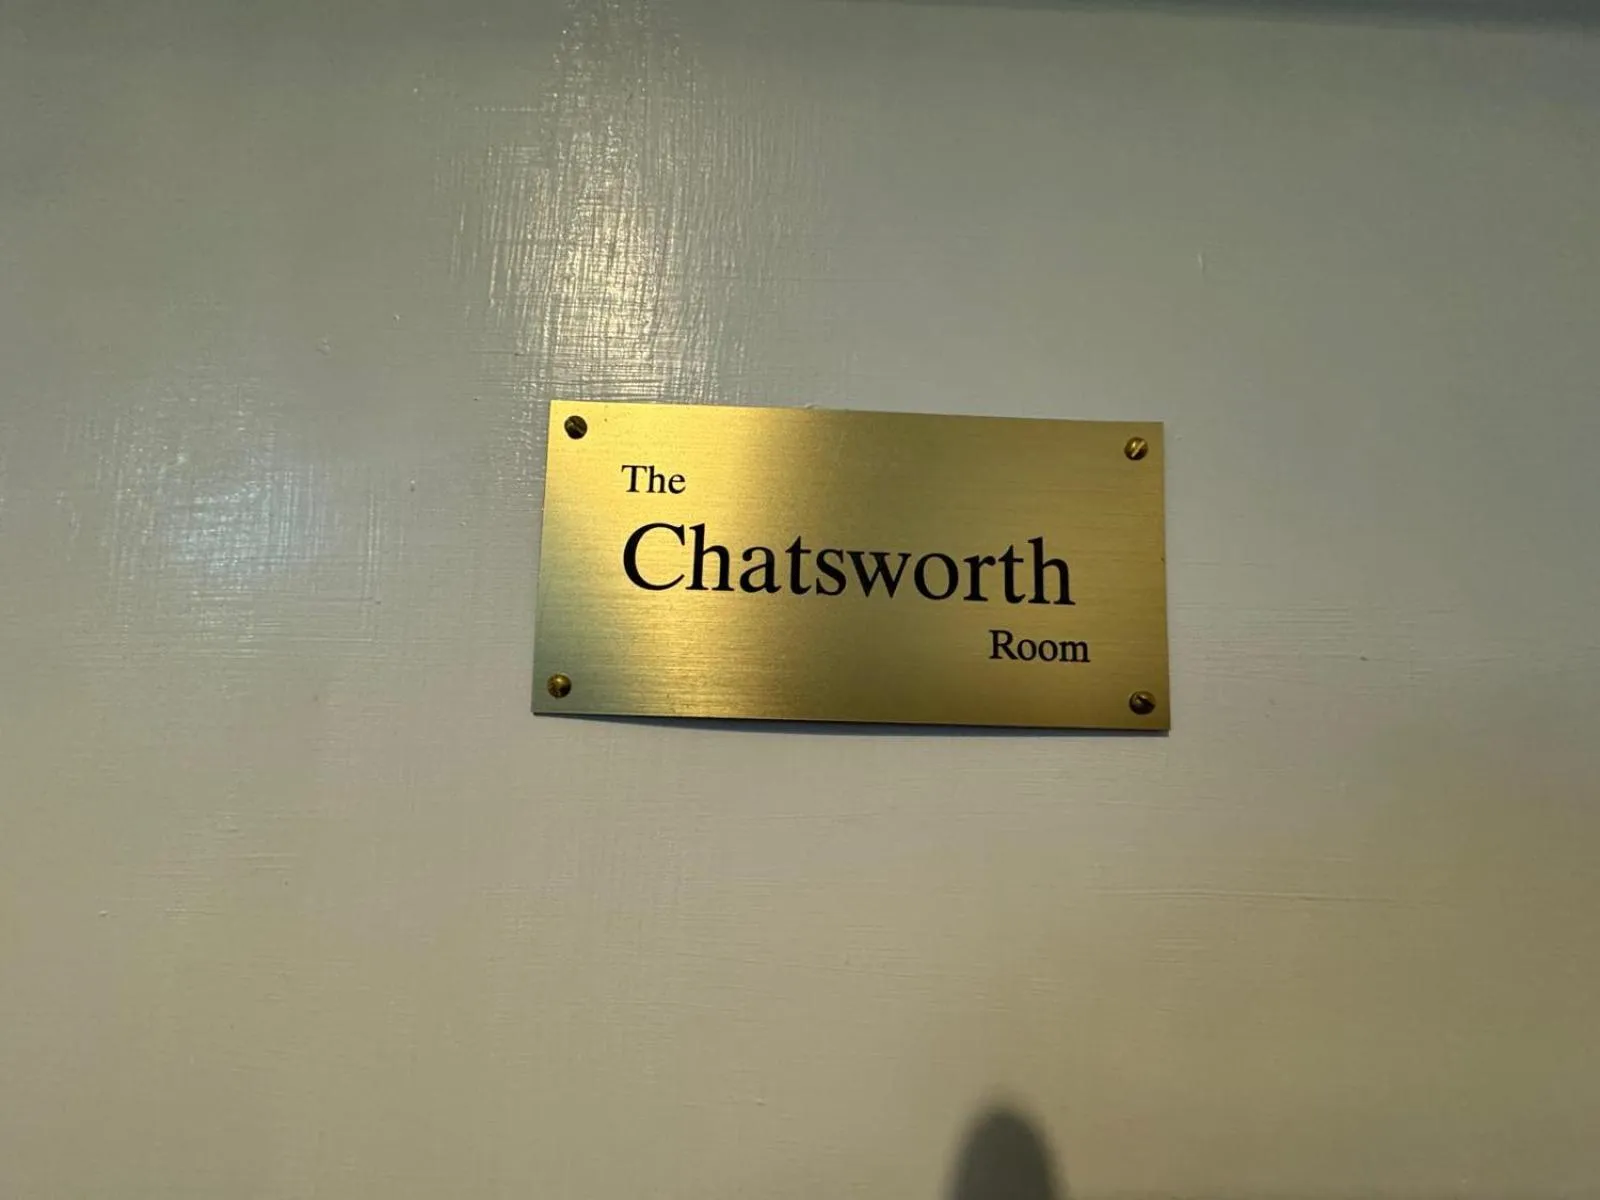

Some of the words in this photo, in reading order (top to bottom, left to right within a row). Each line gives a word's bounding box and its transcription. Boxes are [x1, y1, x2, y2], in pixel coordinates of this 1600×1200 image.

[622, 464, 686, 494] The
[623, 523, 1076, 606] Chatsworth
[989, 629, 1091, 663] Room
